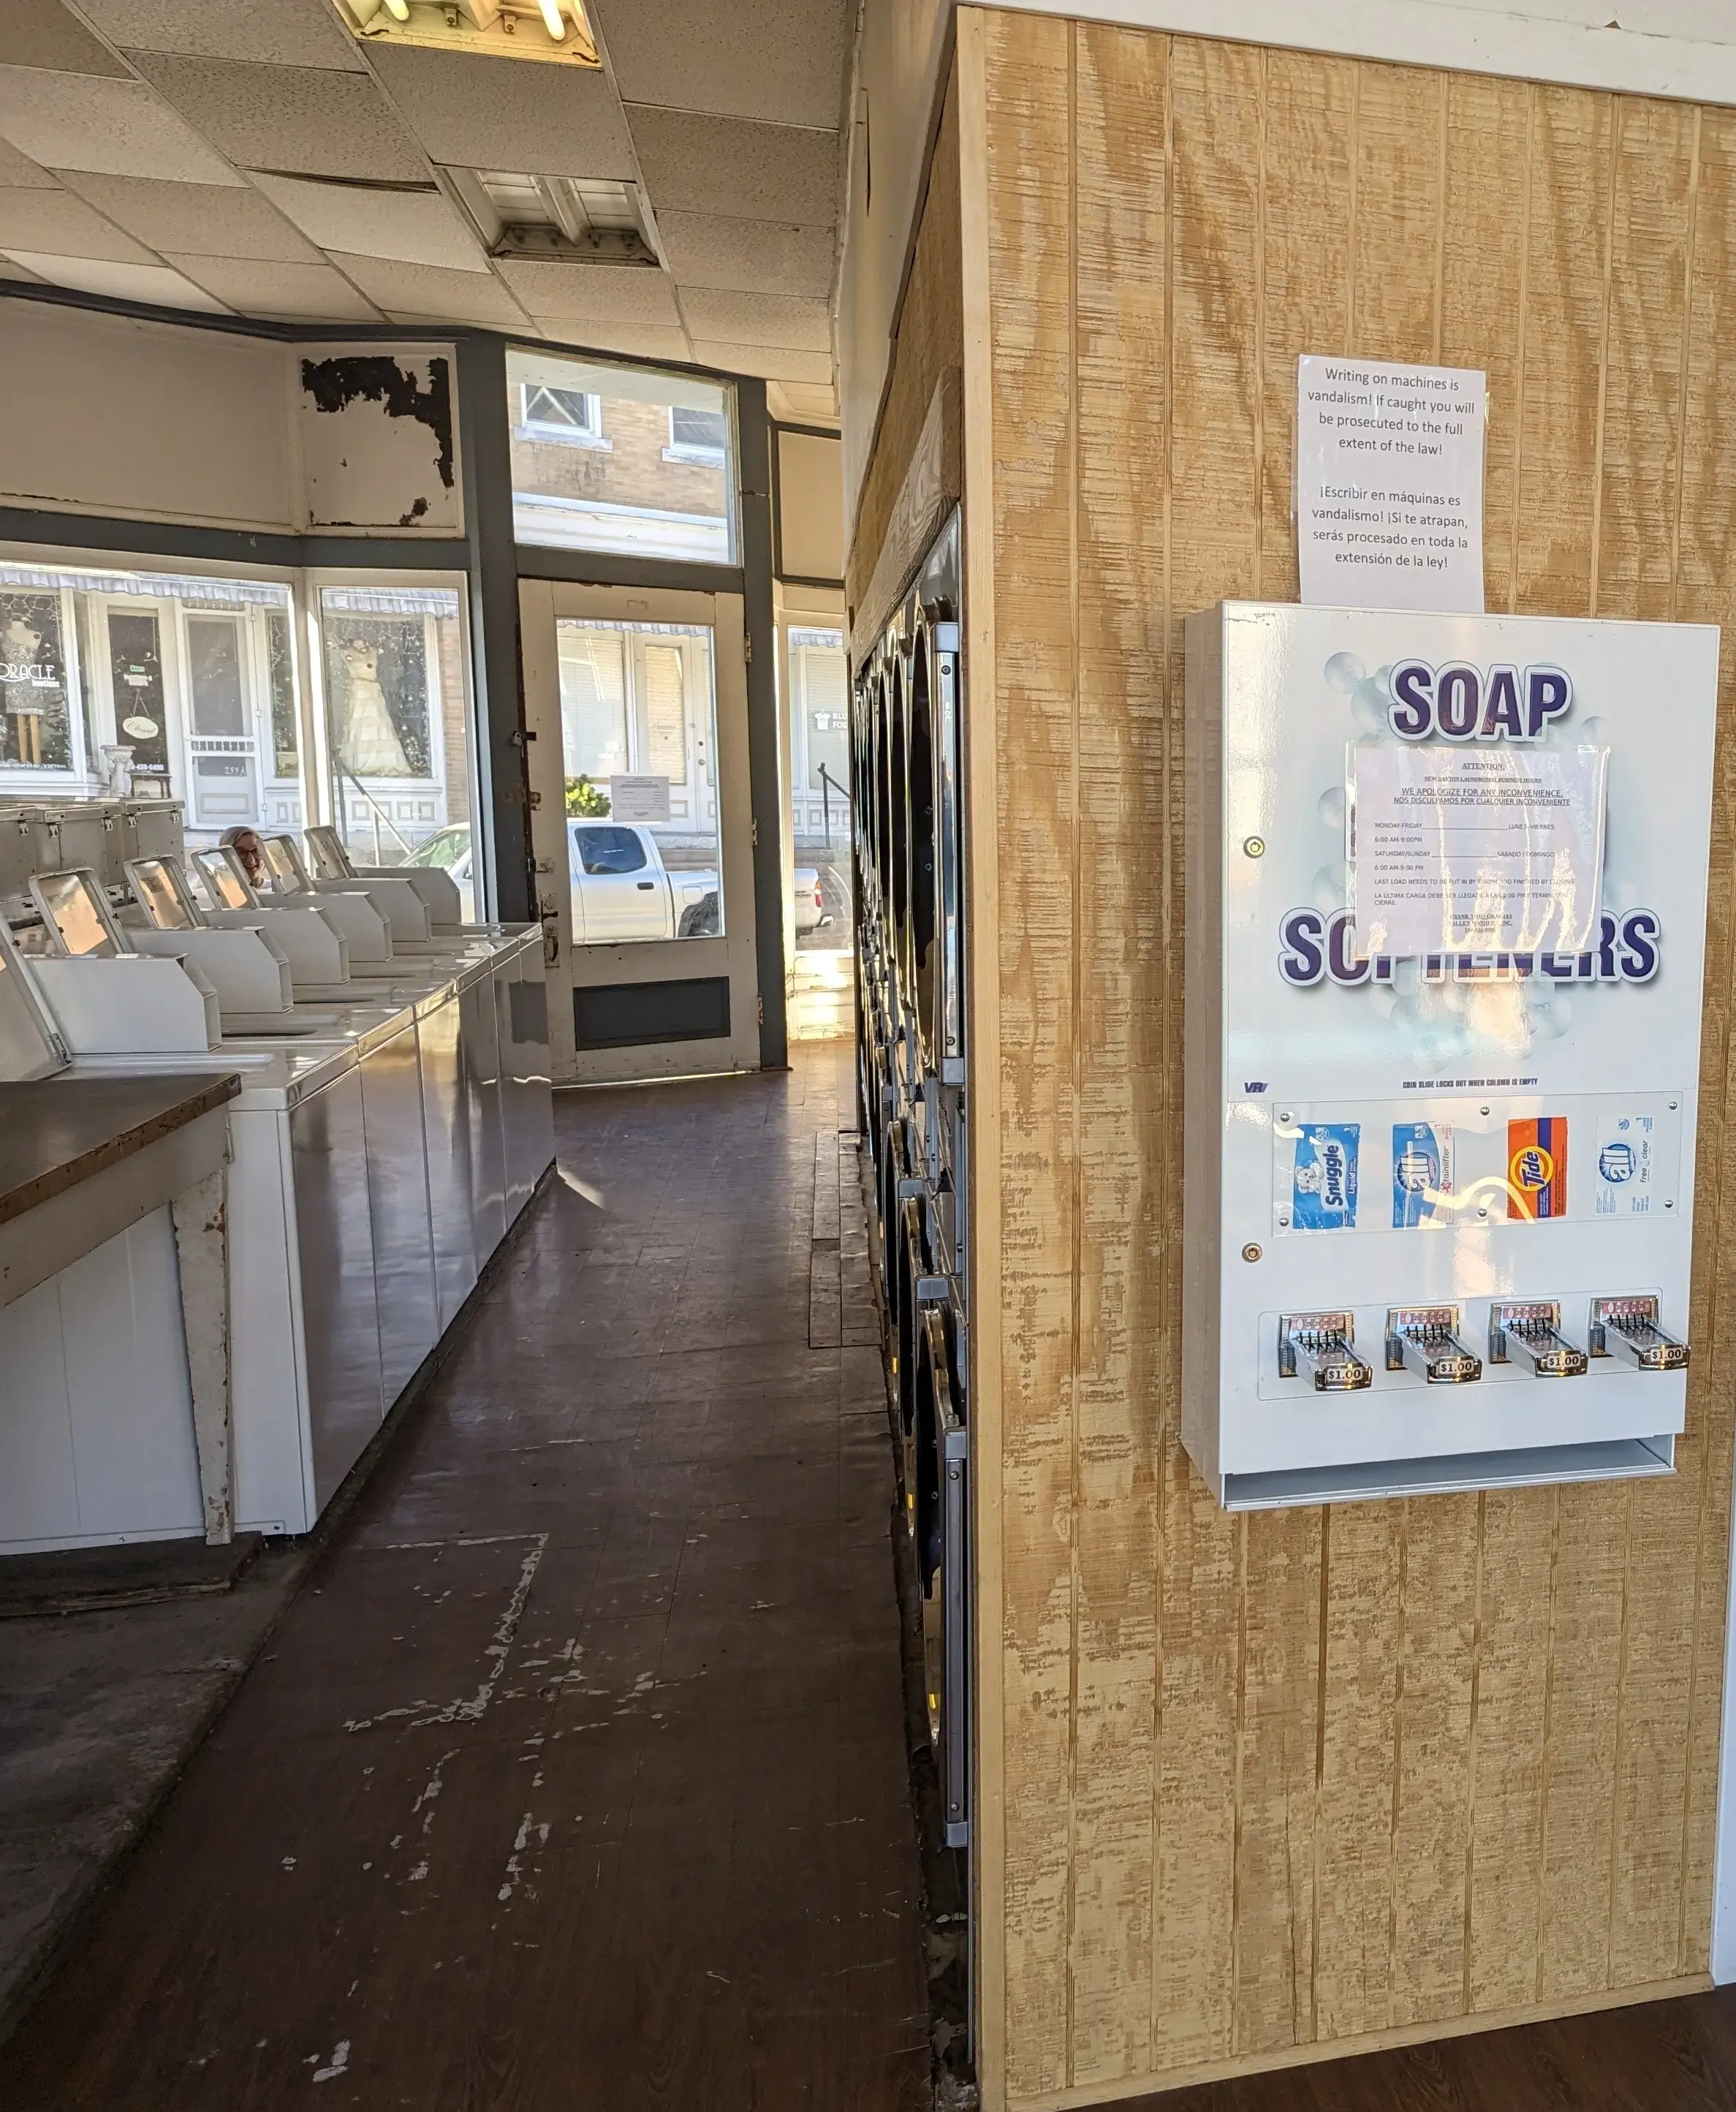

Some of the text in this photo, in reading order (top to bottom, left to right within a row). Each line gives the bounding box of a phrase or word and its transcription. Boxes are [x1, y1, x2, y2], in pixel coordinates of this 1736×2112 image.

[1325, 368, 1459, 390] Writing on machines is
[1308, 391, 1474, 414] vandalism! If caught you will
[1319, 412, 1463, 435] be prosecuted to the full
[1339, 439, 1442, 455] extent of the law!
[1320, 485, 1460, 506] ¡Escribir en máquinas es
[1312, 509, 1468, 529] vandalismo! ¡Si te atrapan,
[1314, 529, 1468, 548] serás procesado en toda la
[1335, 553, 1448, 569] extensión de la ley!
[0, 663, 56, 681] ORACLE
[1391, 664, 1571, 738] SOAP
[1417, 788, 1460, 796] APOLOGIZE
[1400, 1156, 1430, 1189] all
[1521, 1151, 1545, 1187] Tide
[1602, 1148, 1631, 1180] all
[1322, 1145, 1343, 1206] Snuggle
[1348, 1169, 1357, 1195] Liquid
[1549, 1356, 1579, 1366] $1.00
[1652, 1350, 1681, 1359] $1.00
[1329, 1369, 1360, 1379] $1.00
[1441, 1362, 1472, 1372] $1.00
